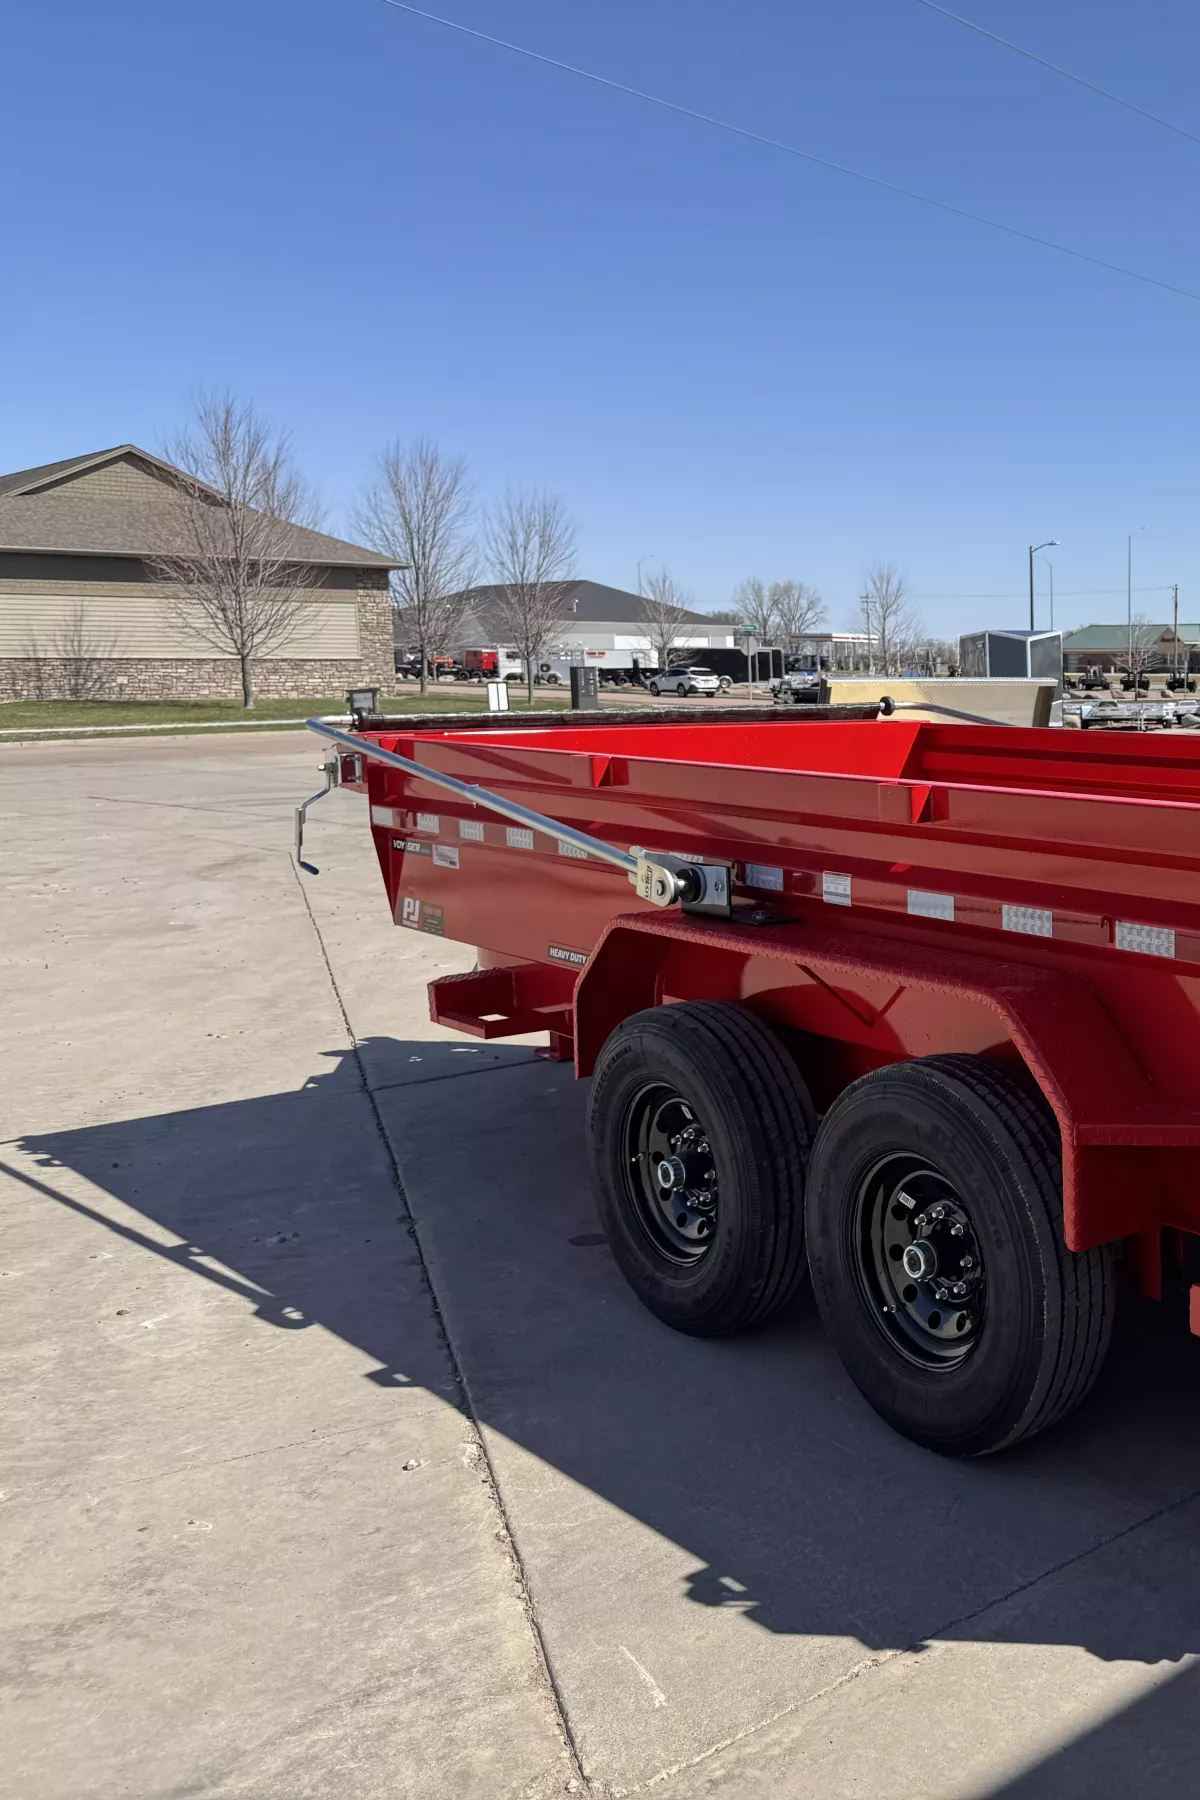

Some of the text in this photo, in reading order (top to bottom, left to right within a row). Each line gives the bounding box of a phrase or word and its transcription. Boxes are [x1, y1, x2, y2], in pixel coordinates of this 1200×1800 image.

[393, 839, 420, 852] VOYGER
[403, 897, 420, 921] PJ
[550, 947, 570, 960] HEAVY
[570, 952, 587, 964] DUTY
